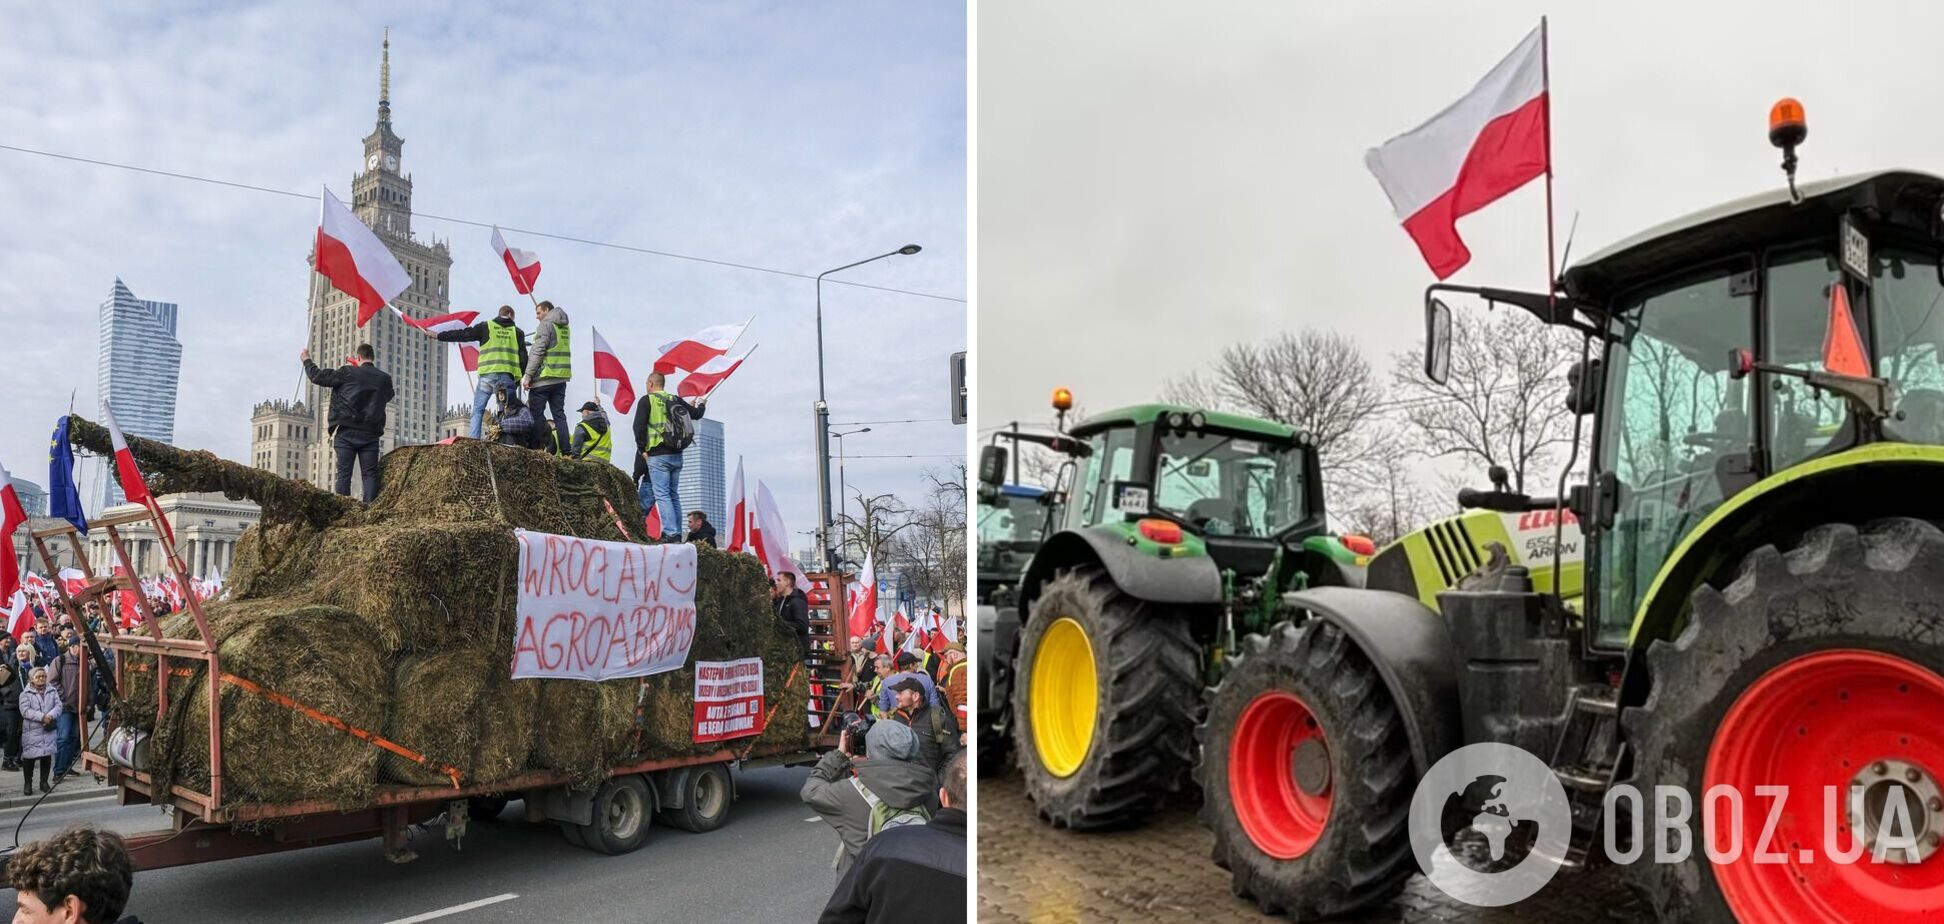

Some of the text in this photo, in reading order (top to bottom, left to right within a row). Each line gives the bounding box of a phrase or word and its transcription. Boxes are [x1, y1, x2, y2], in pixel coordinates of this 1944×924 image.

[1518, 508, 1579, 531] CLAA
[519, 533, 667, 604] WROCŁAW
[1528, 542, 1577, 559] ARION
[511, 604, 695, 672] AGROABRAMS
